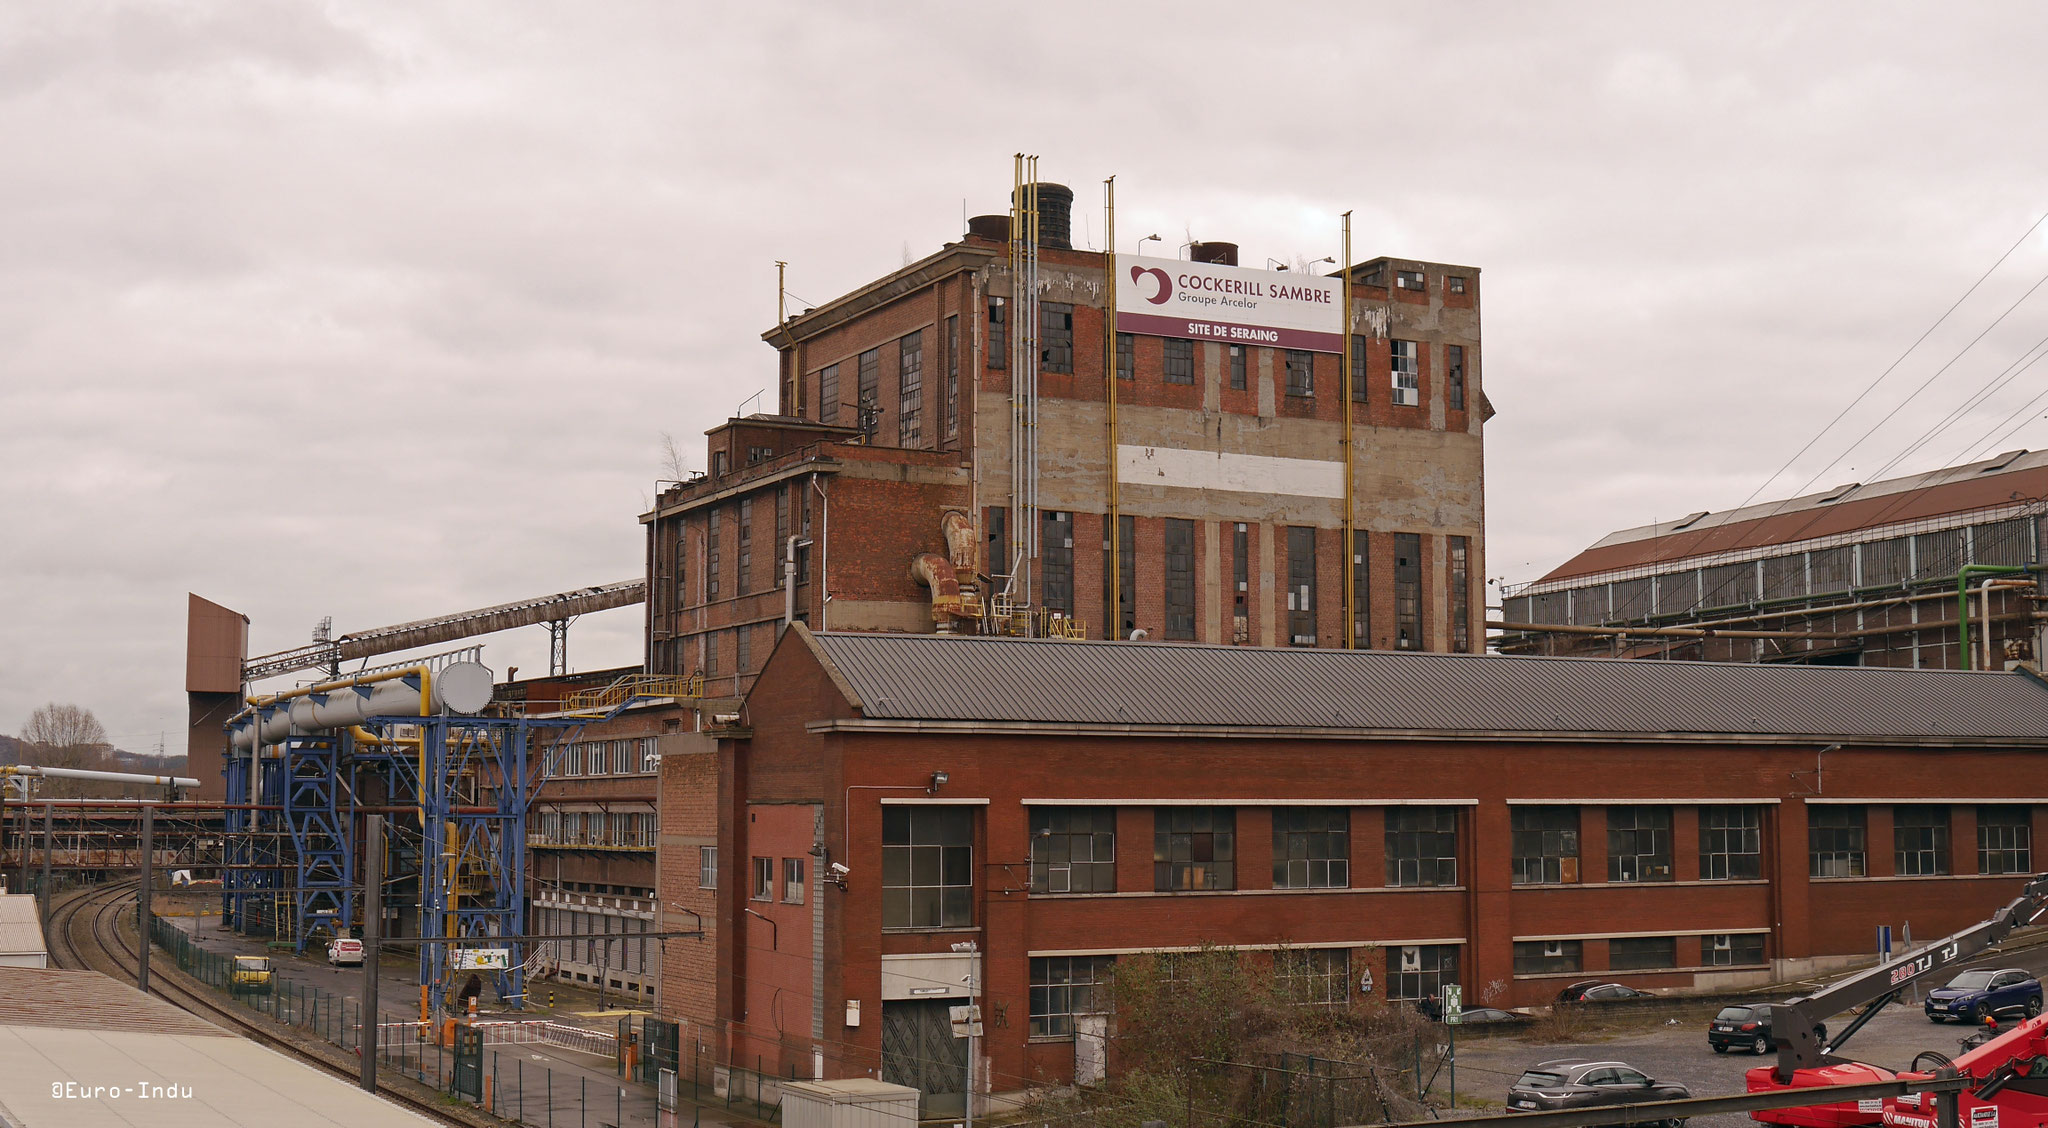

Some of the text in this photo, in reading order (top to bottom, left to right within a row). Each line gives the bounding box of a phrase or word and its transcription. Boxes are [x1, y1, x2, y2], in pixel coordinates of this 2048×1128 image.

[1178, 274, 1331, 304] COCKERILL SAMBRE
[1178, 291, 1258, 309] Groupe Arcelor
[1188, 323, 1279, 342] SITE DE SERAING
[1941, 943, 1958, 960] TJ
[1894, 1114, 1930, 1128] MANITOU
